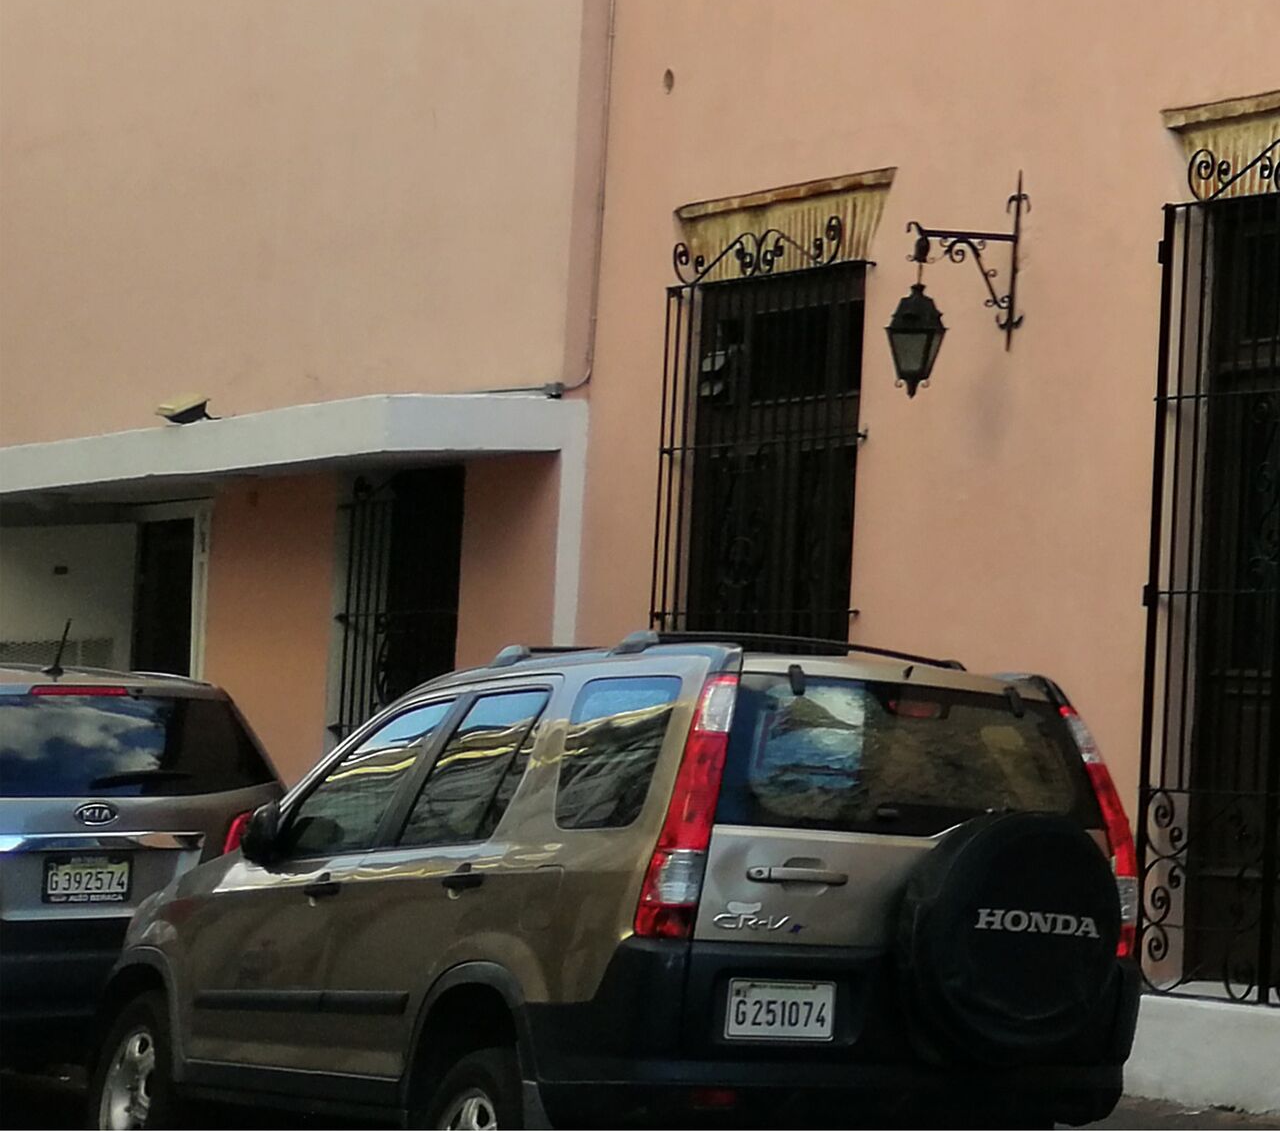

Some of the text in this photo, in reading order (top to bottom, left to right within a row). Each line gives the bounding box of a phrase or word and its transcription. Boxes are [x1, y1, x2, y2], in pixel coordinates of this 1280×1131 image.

[82, 808, 112, 821] KIA
[50, 871, 126, 891] G392574
[712, 913, 791, 931] CR-V
[974, 908, 1101, 939] HONDA
[734, 999, 826, 1028] G251074
